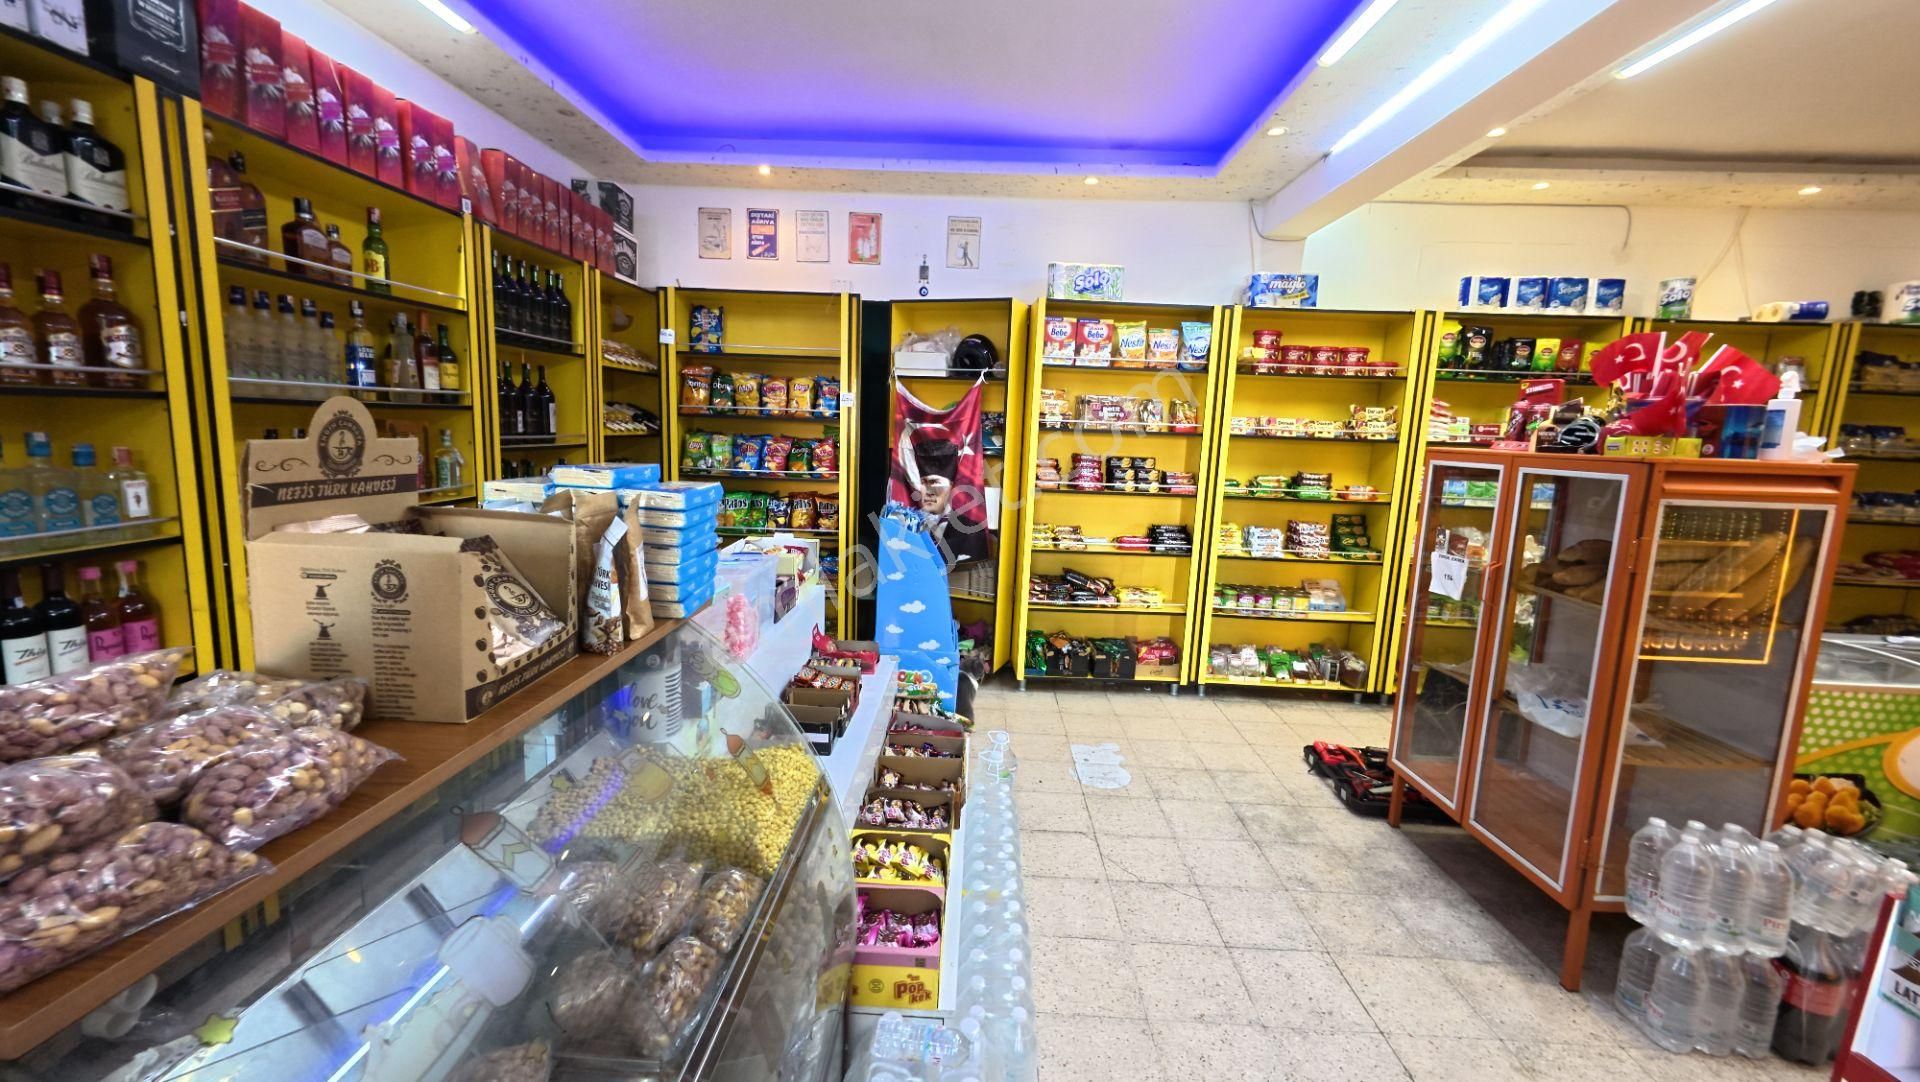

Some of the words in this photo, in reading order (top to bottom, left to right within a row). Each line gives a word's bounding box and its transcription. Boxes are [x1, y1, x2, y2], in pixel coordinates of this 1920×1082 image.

[1557, 282, 1583, 295] Selpak
[1660, 289, 1691, 305] Solo
[1050, 328, 1068, 337] Bebe
[1087, 330, 1105, 339] Bebe
[688, 440, 704, 451] Lay's
[317, 482, 348, 498] TÜRK
[350, 477, 397, 495] KAHVESİ
[724, 498, 749, 510] Patos
[629, 682, 659, 710] love
[894, 979, 925, 999] pop
[909, 989, 932, 1005] kek
